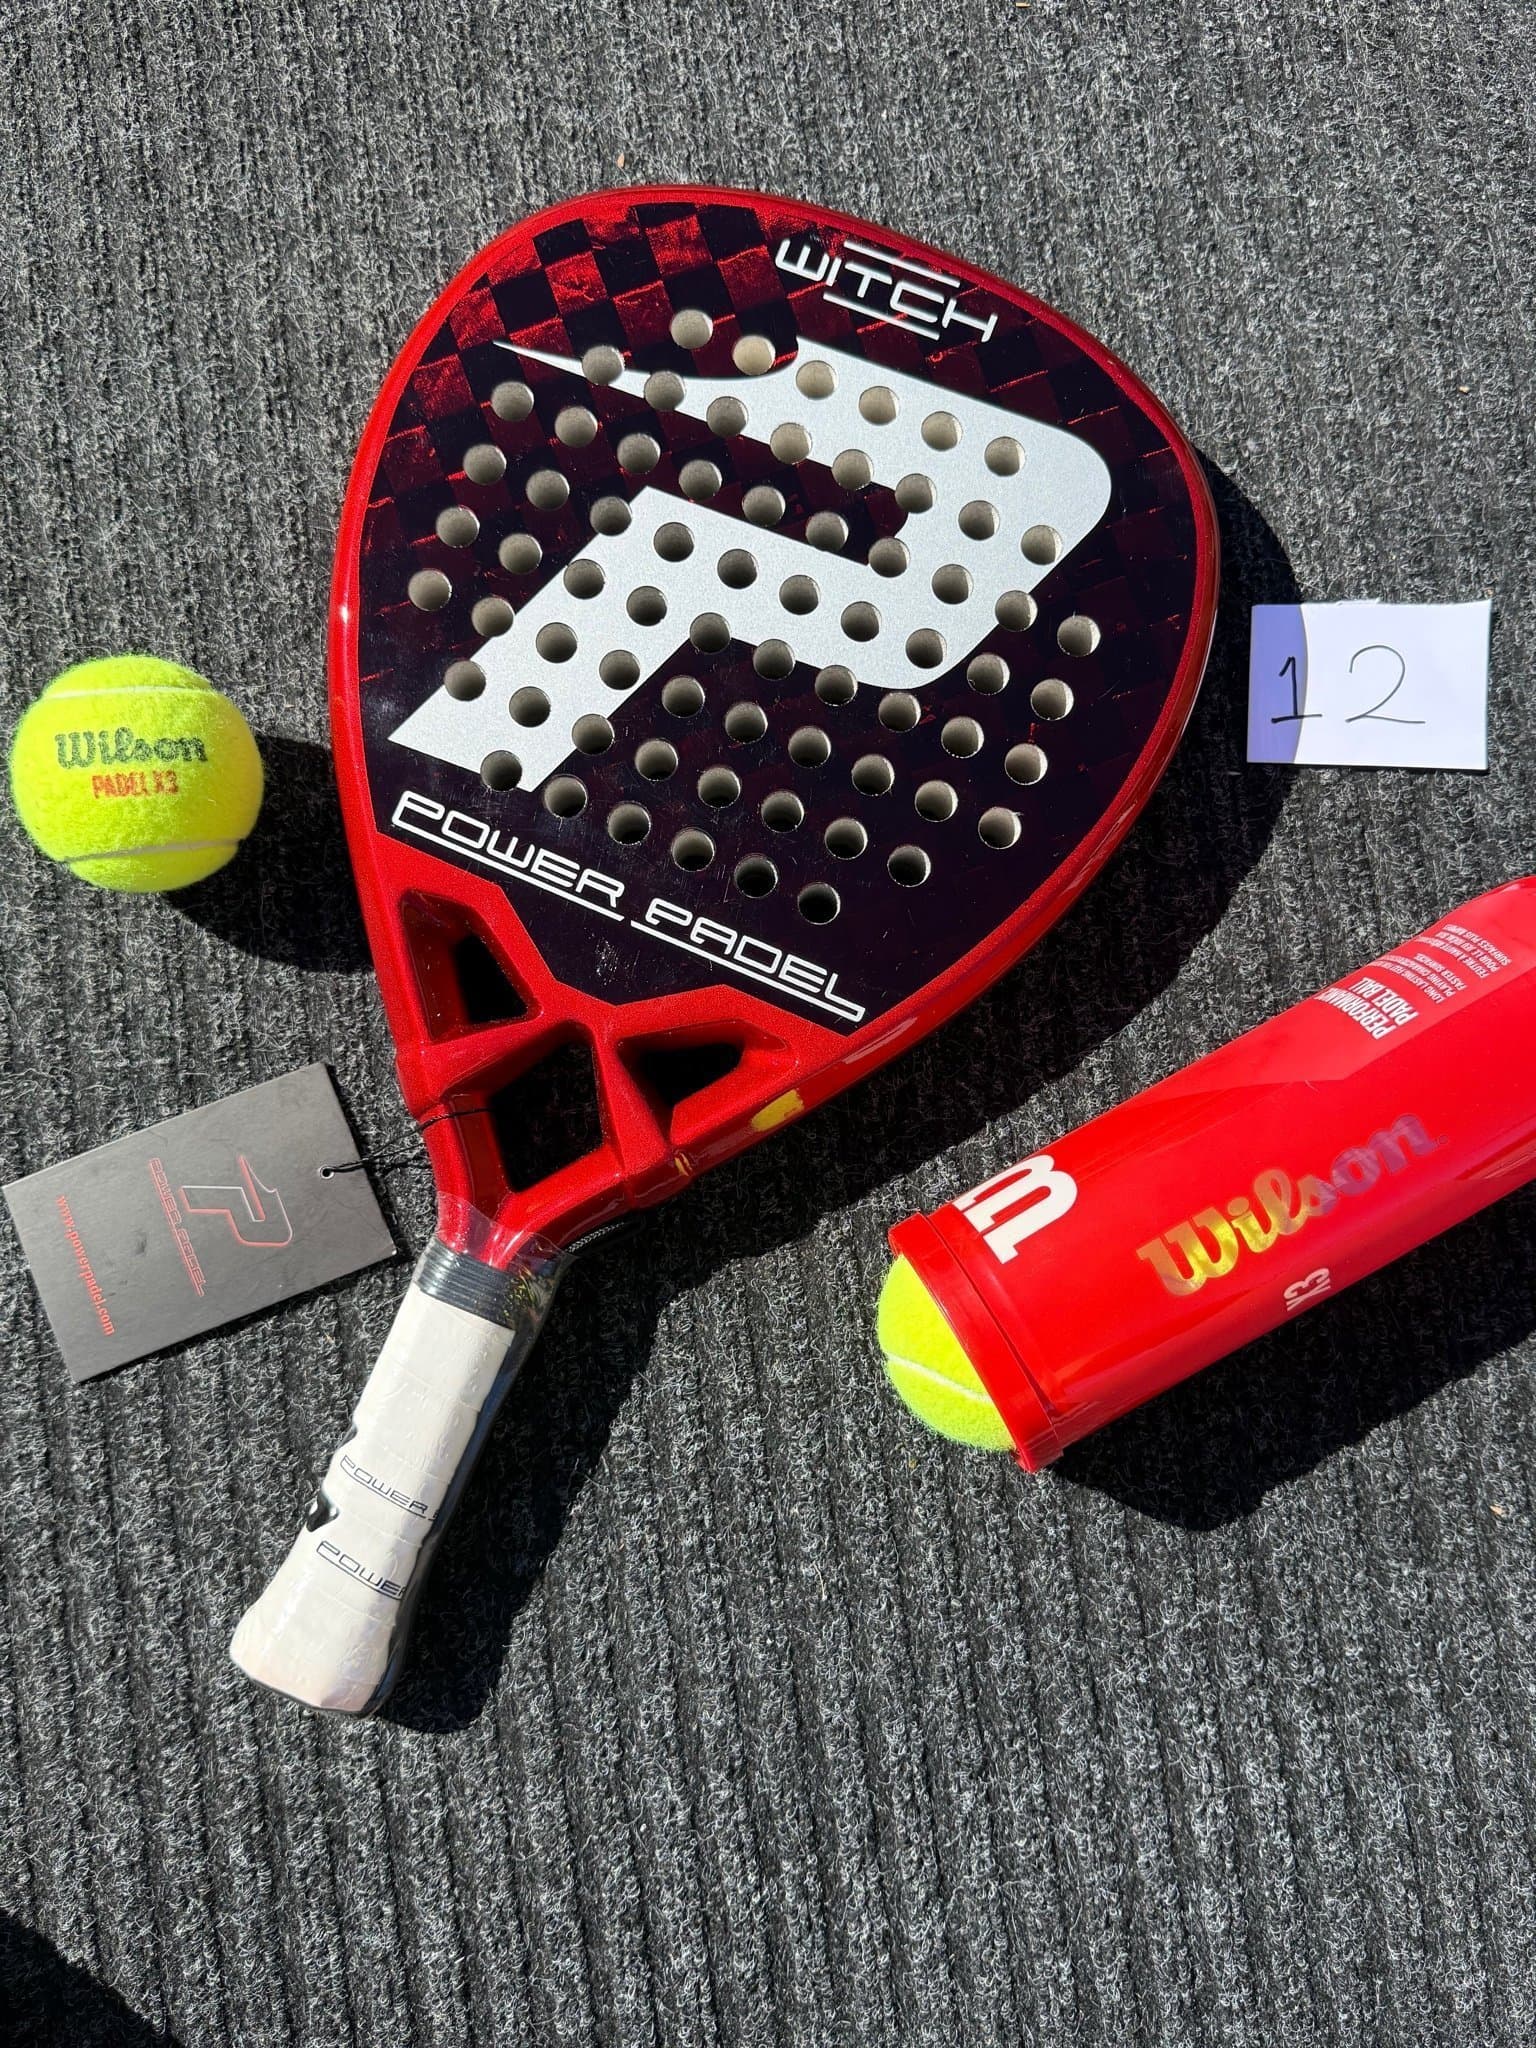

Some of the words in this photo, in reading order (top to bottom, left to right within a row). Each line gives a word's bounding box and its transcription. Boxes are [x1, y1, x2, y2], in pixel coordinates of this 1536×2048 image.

[775, 238, 998, 343] WITCH
[54, 727, 208, 769] Wilson
[91, 771, 151, 799] PADEL
[391, 790, 626, 921] POWER
[631, 898, 866, 1023] PADEL
[1348, 976, 1386, 999] BALL
[1371, 987, 1419, 1026] PADEL
[1135, 1113, 1438, 1298] Wilson
[56, 1194, 116, 1336] www.powerpadel.com
[340, 1455, 428, 1519] POWER
